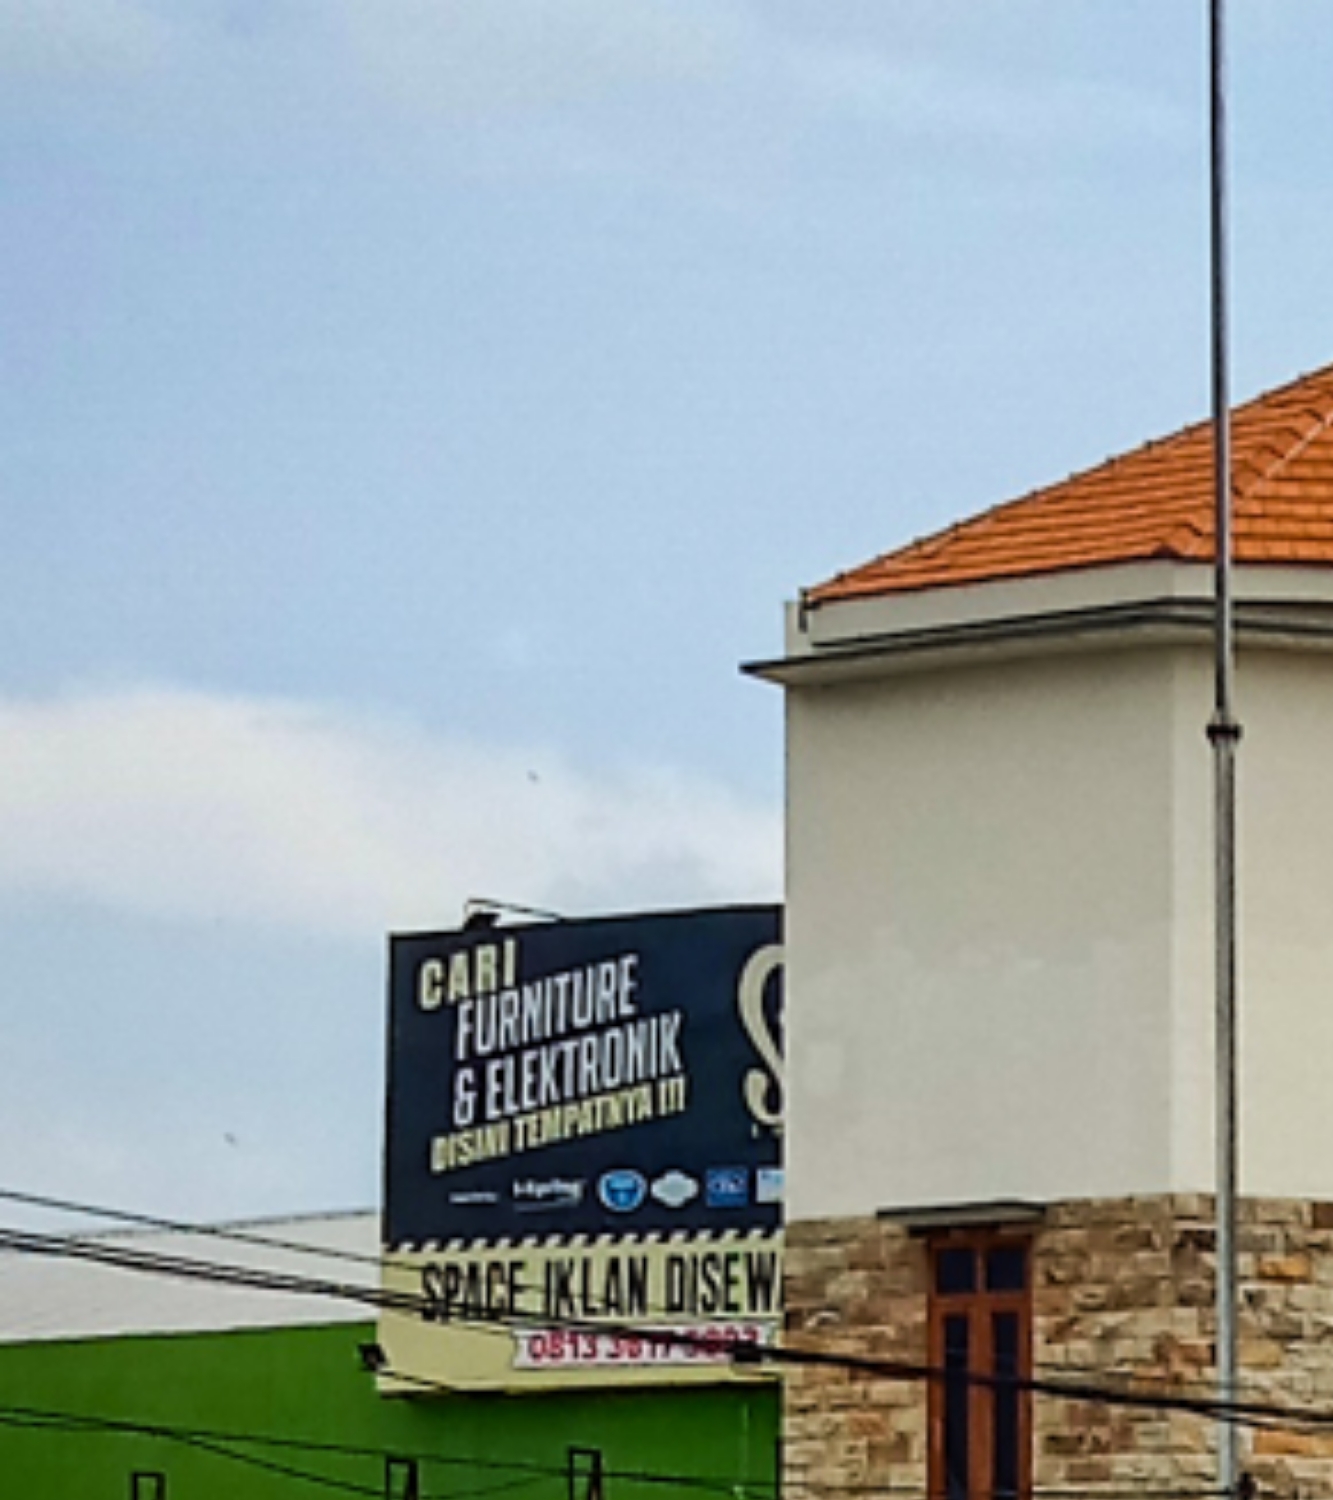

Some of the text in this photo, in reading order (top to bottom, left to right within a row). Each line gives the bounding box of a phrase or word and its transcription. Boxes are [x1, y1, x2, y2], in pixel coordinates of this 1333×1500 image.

[420, 937, 518, 1011] CARI
[456, 953, 639, 1062] FURNITURE
[453, 1009, 684, 1127] & ELEKTRONIK
[420, 1251, 785, 1322] SPACE IKLAN DISEW
